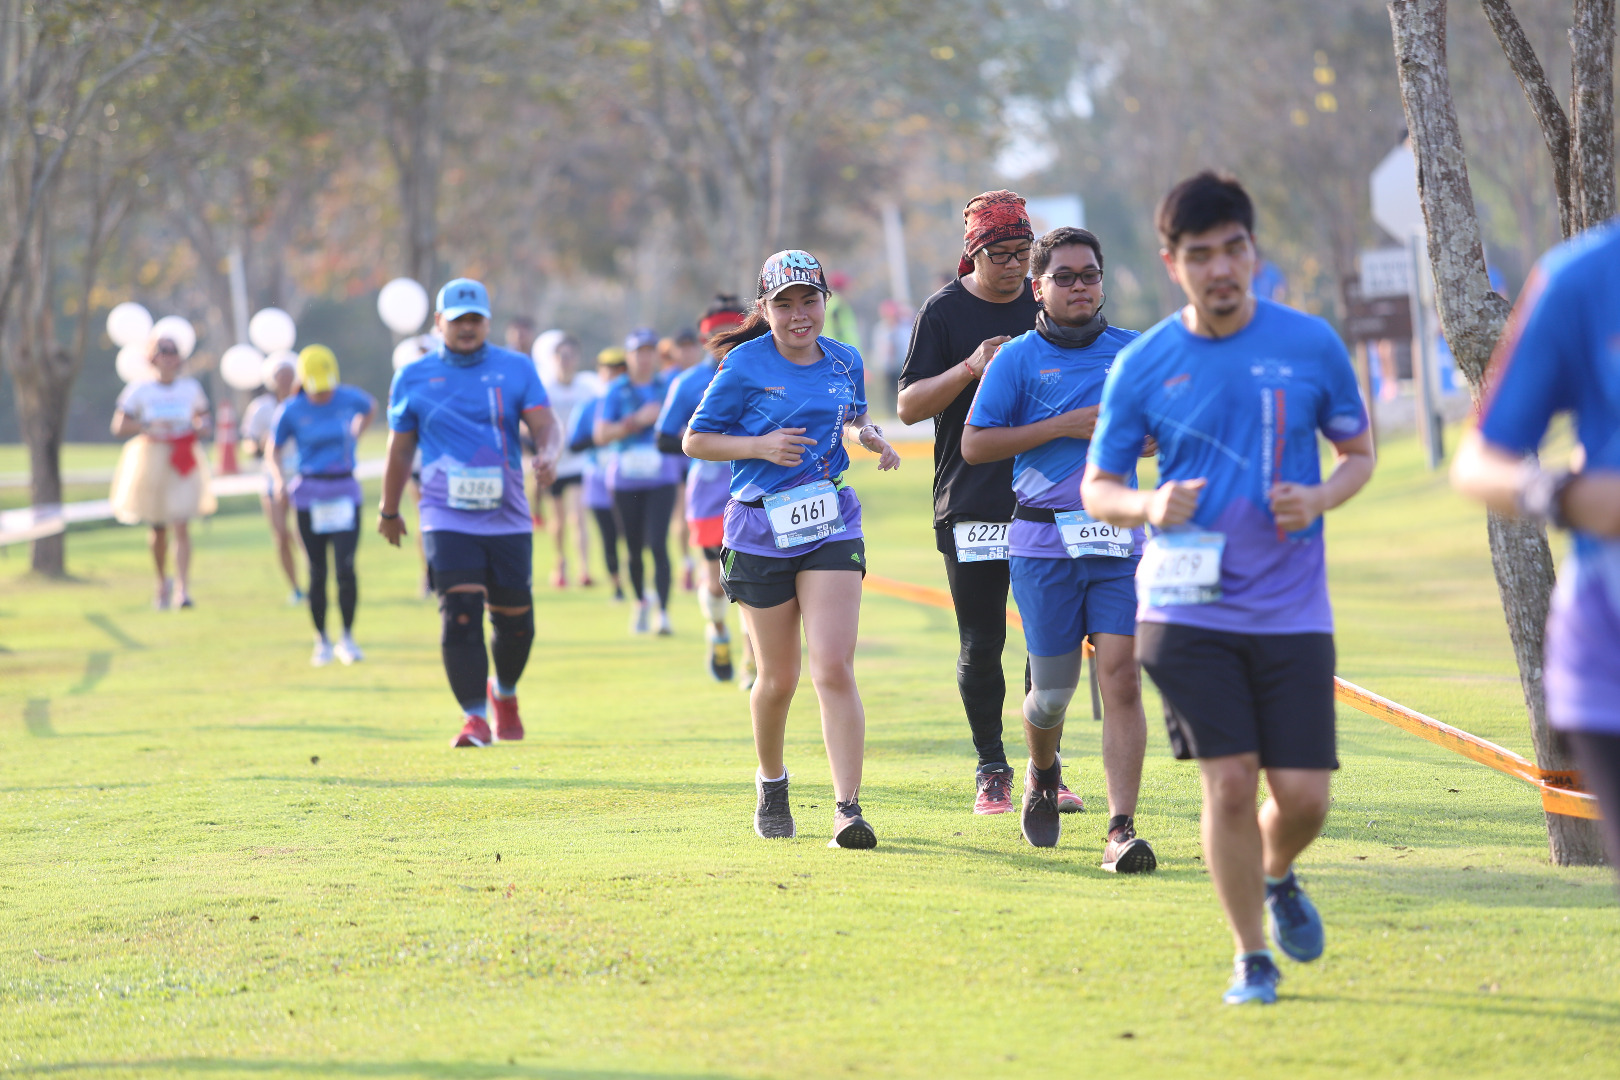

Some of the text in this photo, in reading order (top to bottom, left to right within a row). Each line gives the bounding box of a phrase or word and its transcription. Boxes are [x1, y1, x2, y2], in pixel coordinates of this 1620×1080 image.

[835, 404, 844, 431] CROSS
[457, 480, 496, 495] 6386
[790, 499, 826, 525] 6161
[967, 524, 1008, 543] 6221
